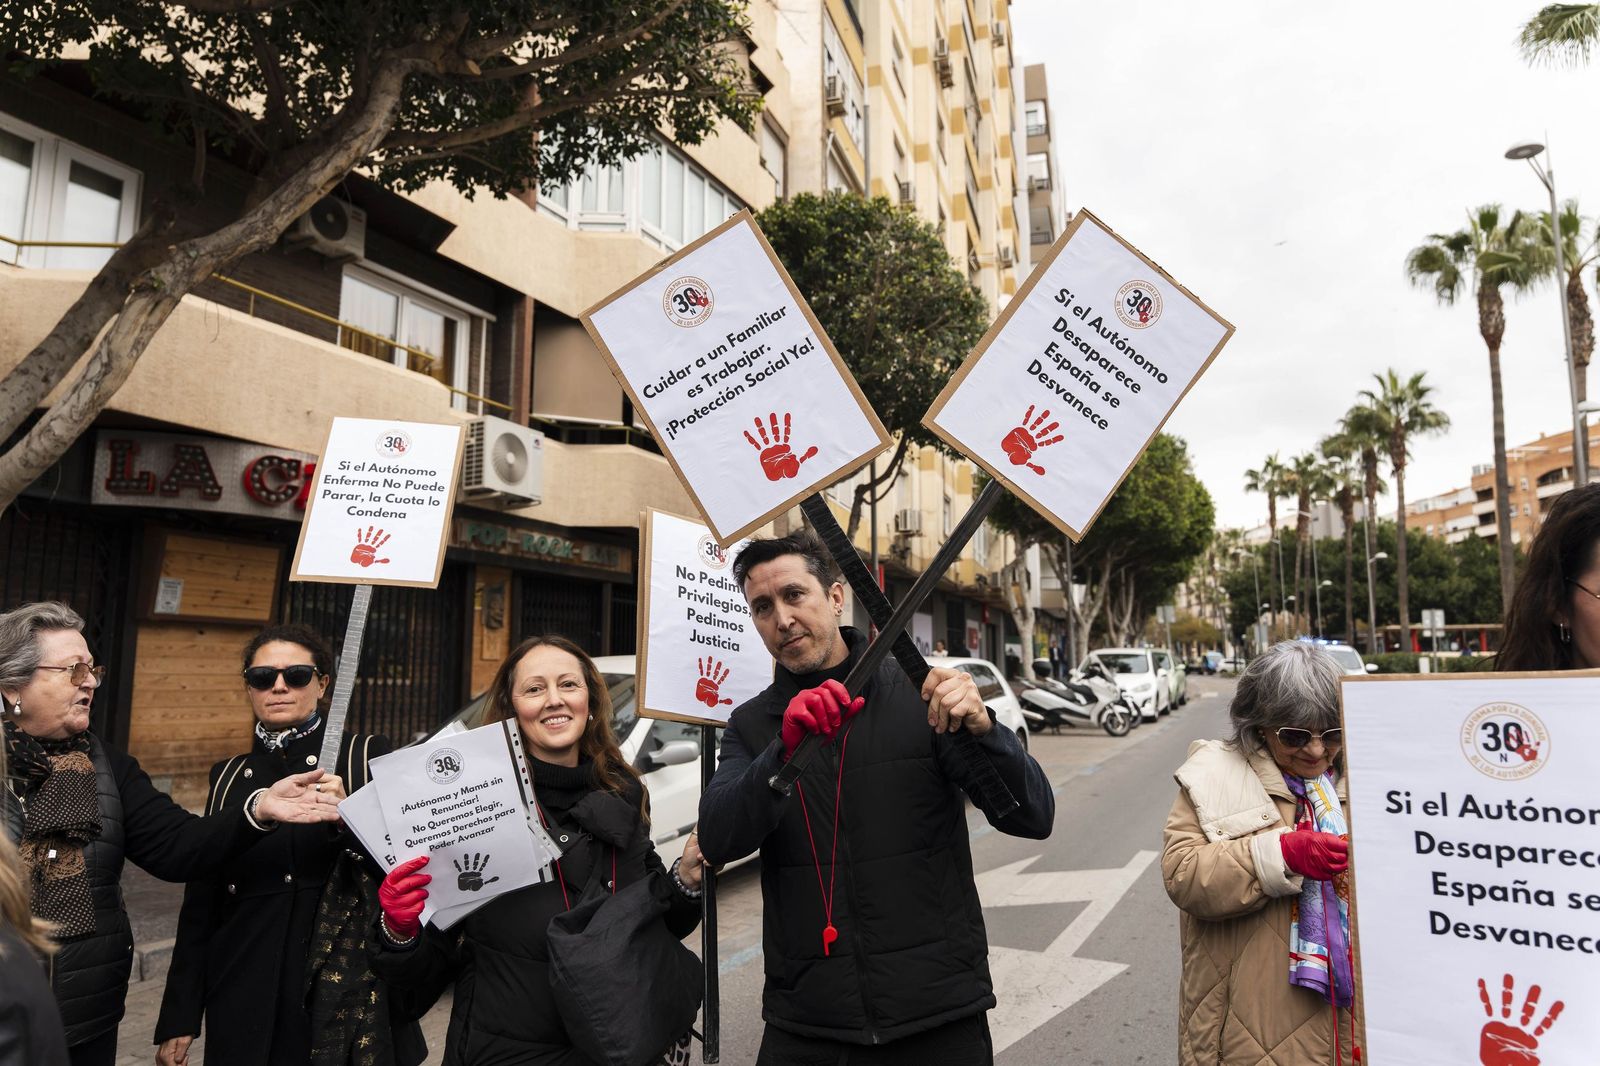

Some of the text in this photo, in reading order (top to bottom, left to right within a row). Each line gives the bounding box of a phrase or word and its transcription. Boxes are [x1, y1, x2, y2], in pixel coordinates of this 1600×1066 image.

[672, 287, 700, 314] 30
[690, 308, 697, 316] N
[1126, 289, 1152, 316] 30
[1128, 308, 1136, 316] N
[1053, 288, 1168, 385] Si el Autónomo
[642, 305, 786, 399] Cuidar a un Familiar
[1051, 316, 1141, 395] Desaparece
[687, 344, 771, 399] es Trabajar.
[1043, 341, 1120, 409] España se
[665, 336, 815, 441] ¡Protección Social Ya!
[1026, 358, 1109, 430] Desvanece
[384, 436, 403, 449] 30
[105, 439, 223, 501] LA
[338, 460, 437, 477] Si el Autónomo
[322, 474, 445, 492] Enferma No Puede
[322, 489, 441, 507] Parar, la Cuota lo
[346, 505, 407, 519] Condena
[676, 564, 697, 581] No
[678, 585, 752, 618] Privilegios,
[687, 607, 744, 634] Pedimos
[689, 628, 740, 653] Justicia
[1481, 721, 1524, 752] 30
[435, 756, 455, 774] 30
[1499, 753, 1508, 762] N
[401, 793, 452, 815] ¡Autónoma
[453, 790, 460, 800] y
[460, 780, 489, 796] Mamá
[490, 777, 504, 786] sin
[431, 794, 480, 816] Renunciar!
[1385, 790, 1413, 815] Si
[1422, 792, 1448, 817] el
[404, 828, 452, 848] Queremos
[452, 815, 493, 834] Derechos
[494, 807, 516, 821] para
[412, 800, 504, 834] No Queremos Elegir,
[428, 825, 495, 852] Poder Avanzar
[1414, 830, 1600, 868] Desaparec
[1431, 871, 1600, 912] España se
[1429, 910, 1600, 954] Desvanec
